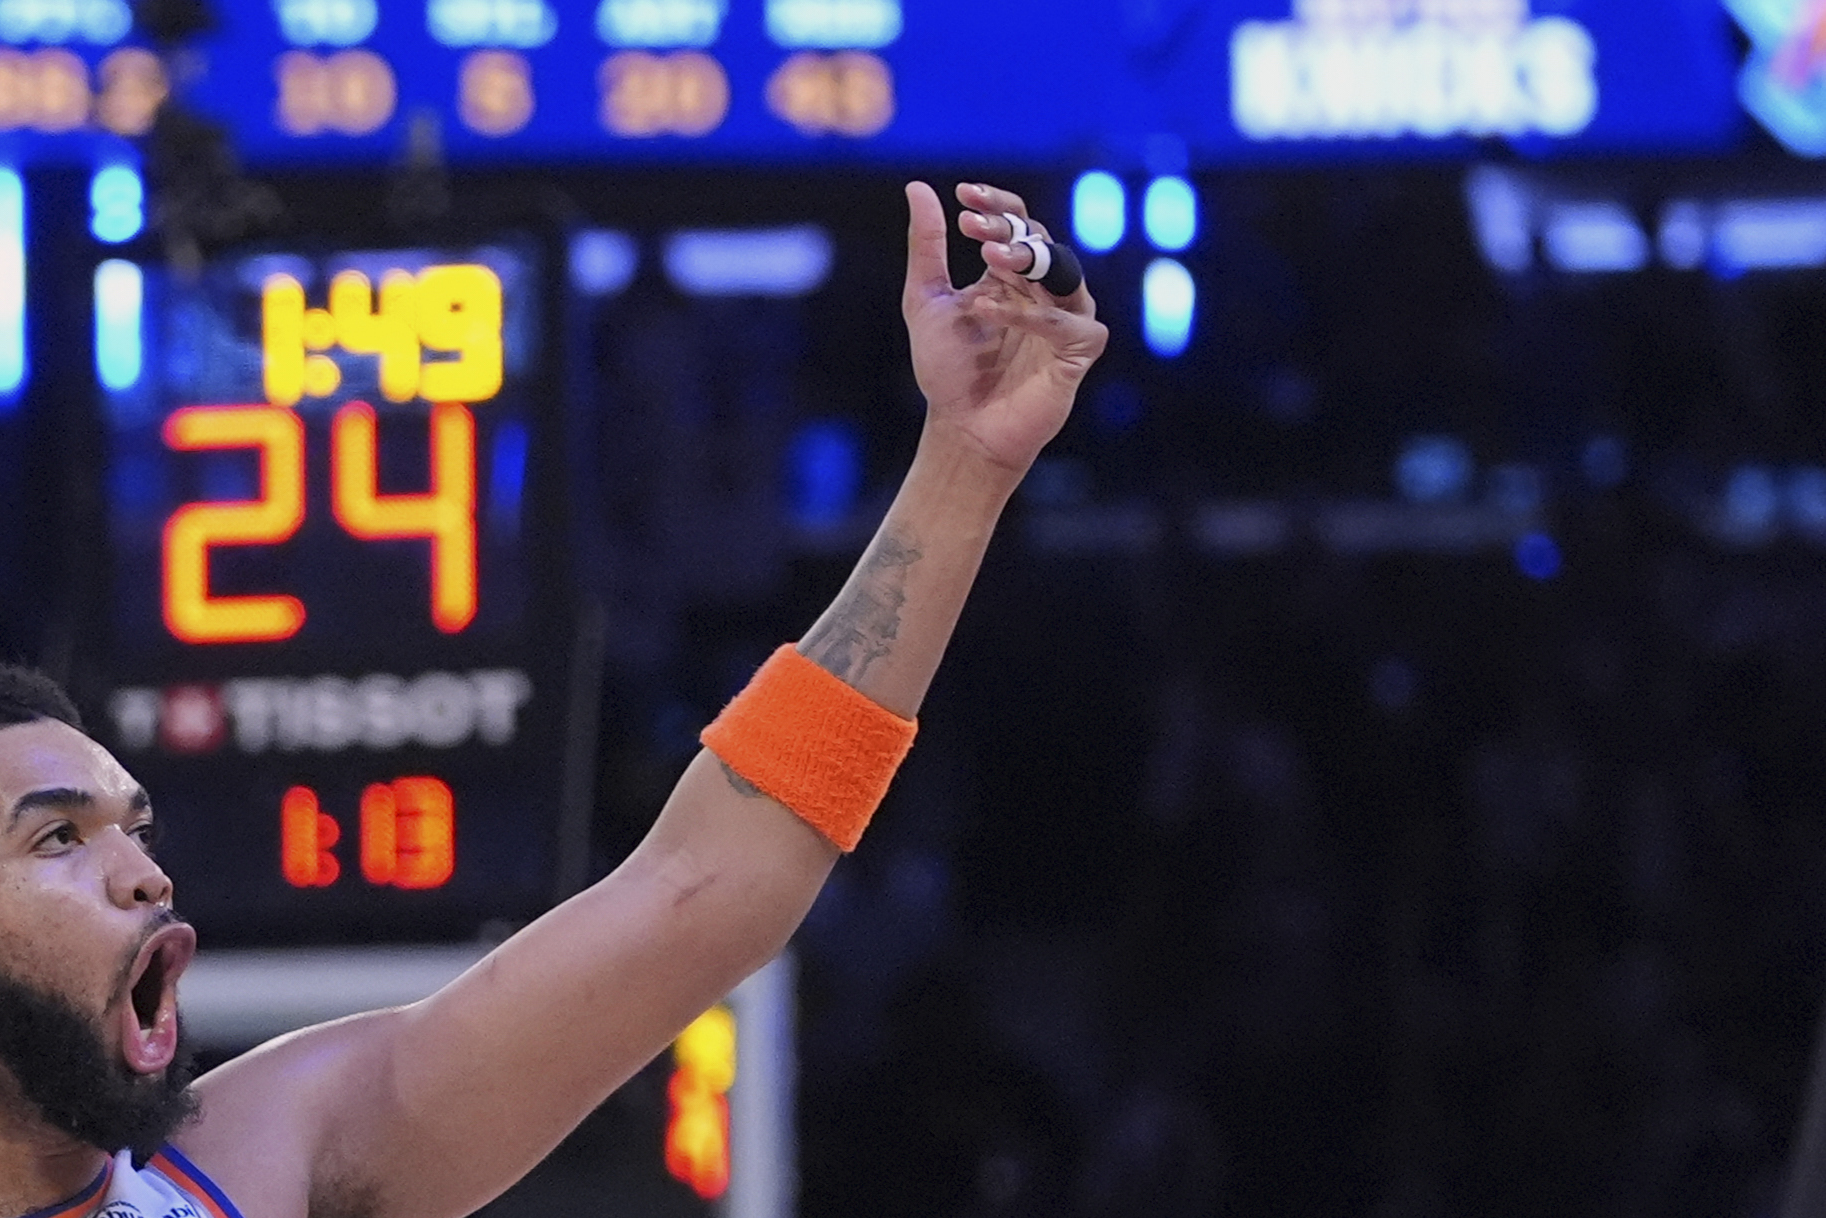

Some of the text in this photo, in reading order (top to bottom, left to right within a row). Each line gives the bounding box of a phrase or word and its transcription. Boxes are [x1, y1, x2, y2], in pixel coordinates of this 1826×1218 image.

[263, 264, 503, 403] 1:49
[162, 402, 477, 642] 24
[229, 668, 528, 752] TISSOT
